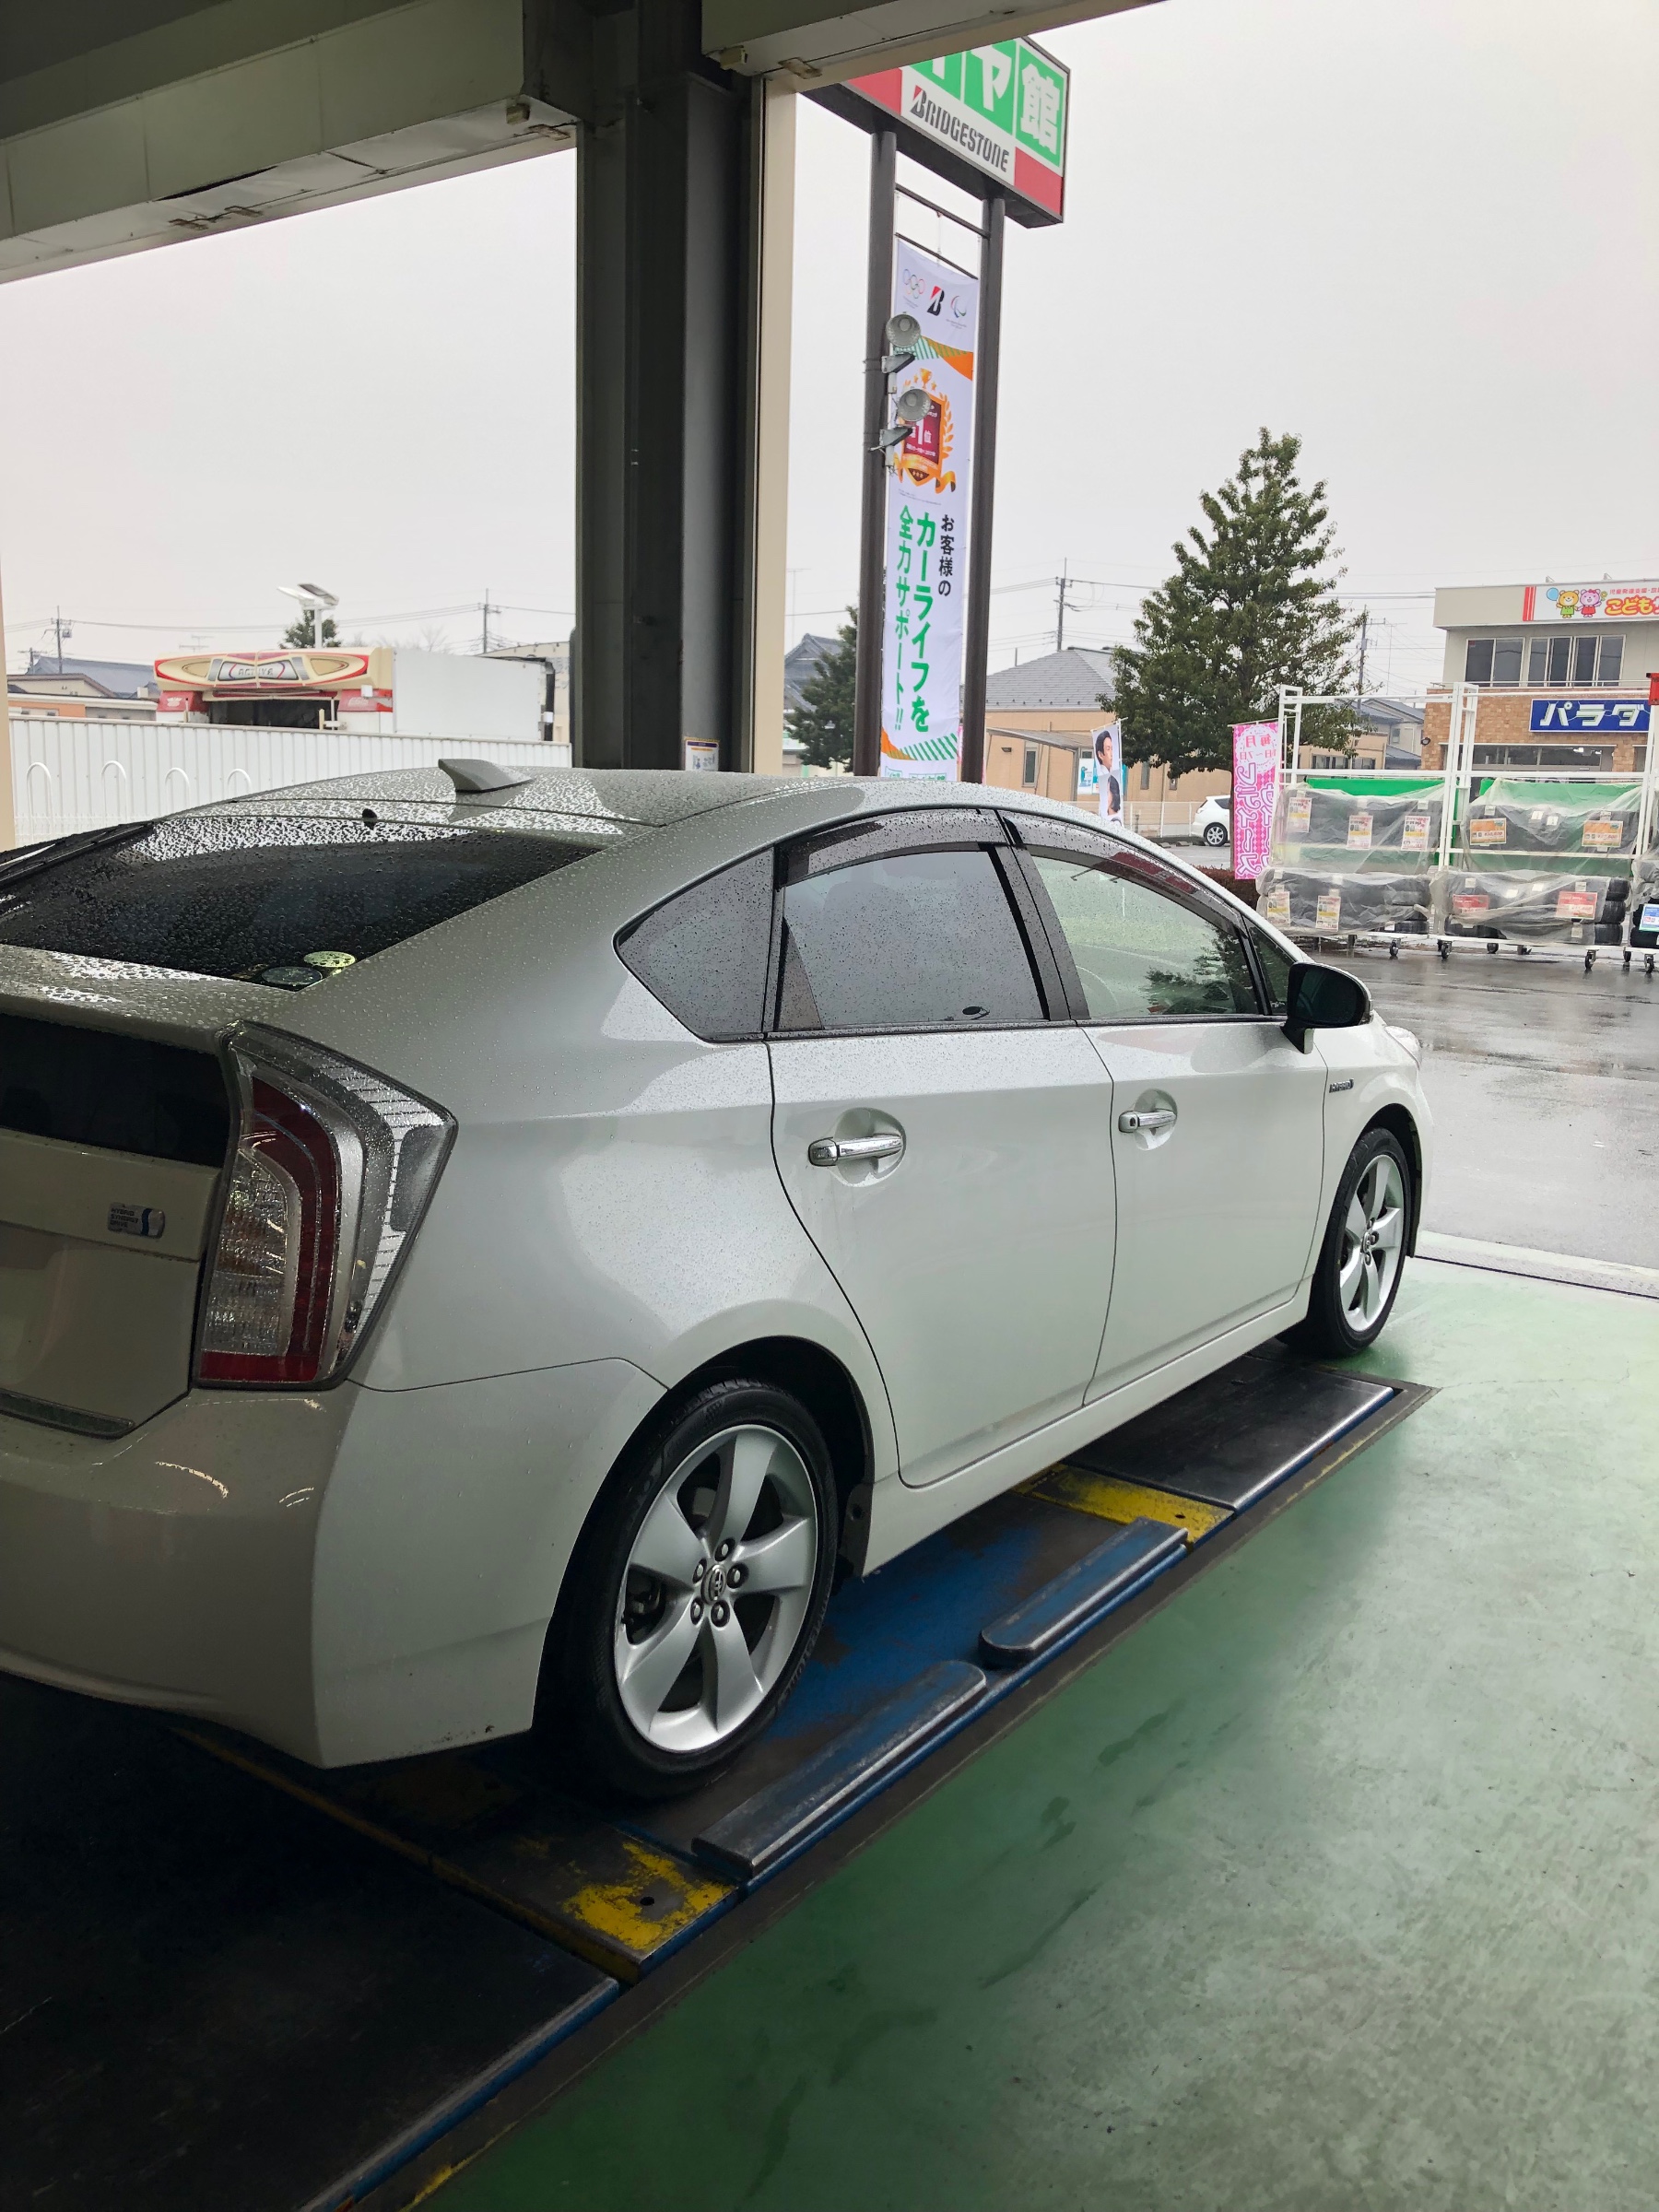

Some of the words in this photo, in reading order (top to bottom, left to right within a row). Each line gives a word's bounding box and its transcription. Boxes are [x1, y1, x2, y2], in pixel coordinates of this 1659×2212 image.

[910, 85, 1010, 173] BRIDGESTONE
[937, 513, 955, 597] お客様の
[911, 512, 936, 734] カーライフを
[110, 1219, 128, 1228] DRIVE
[111, 1207, 135, 1217] HYBRID
[111, 1214, 138, 1224] SYNERGY
